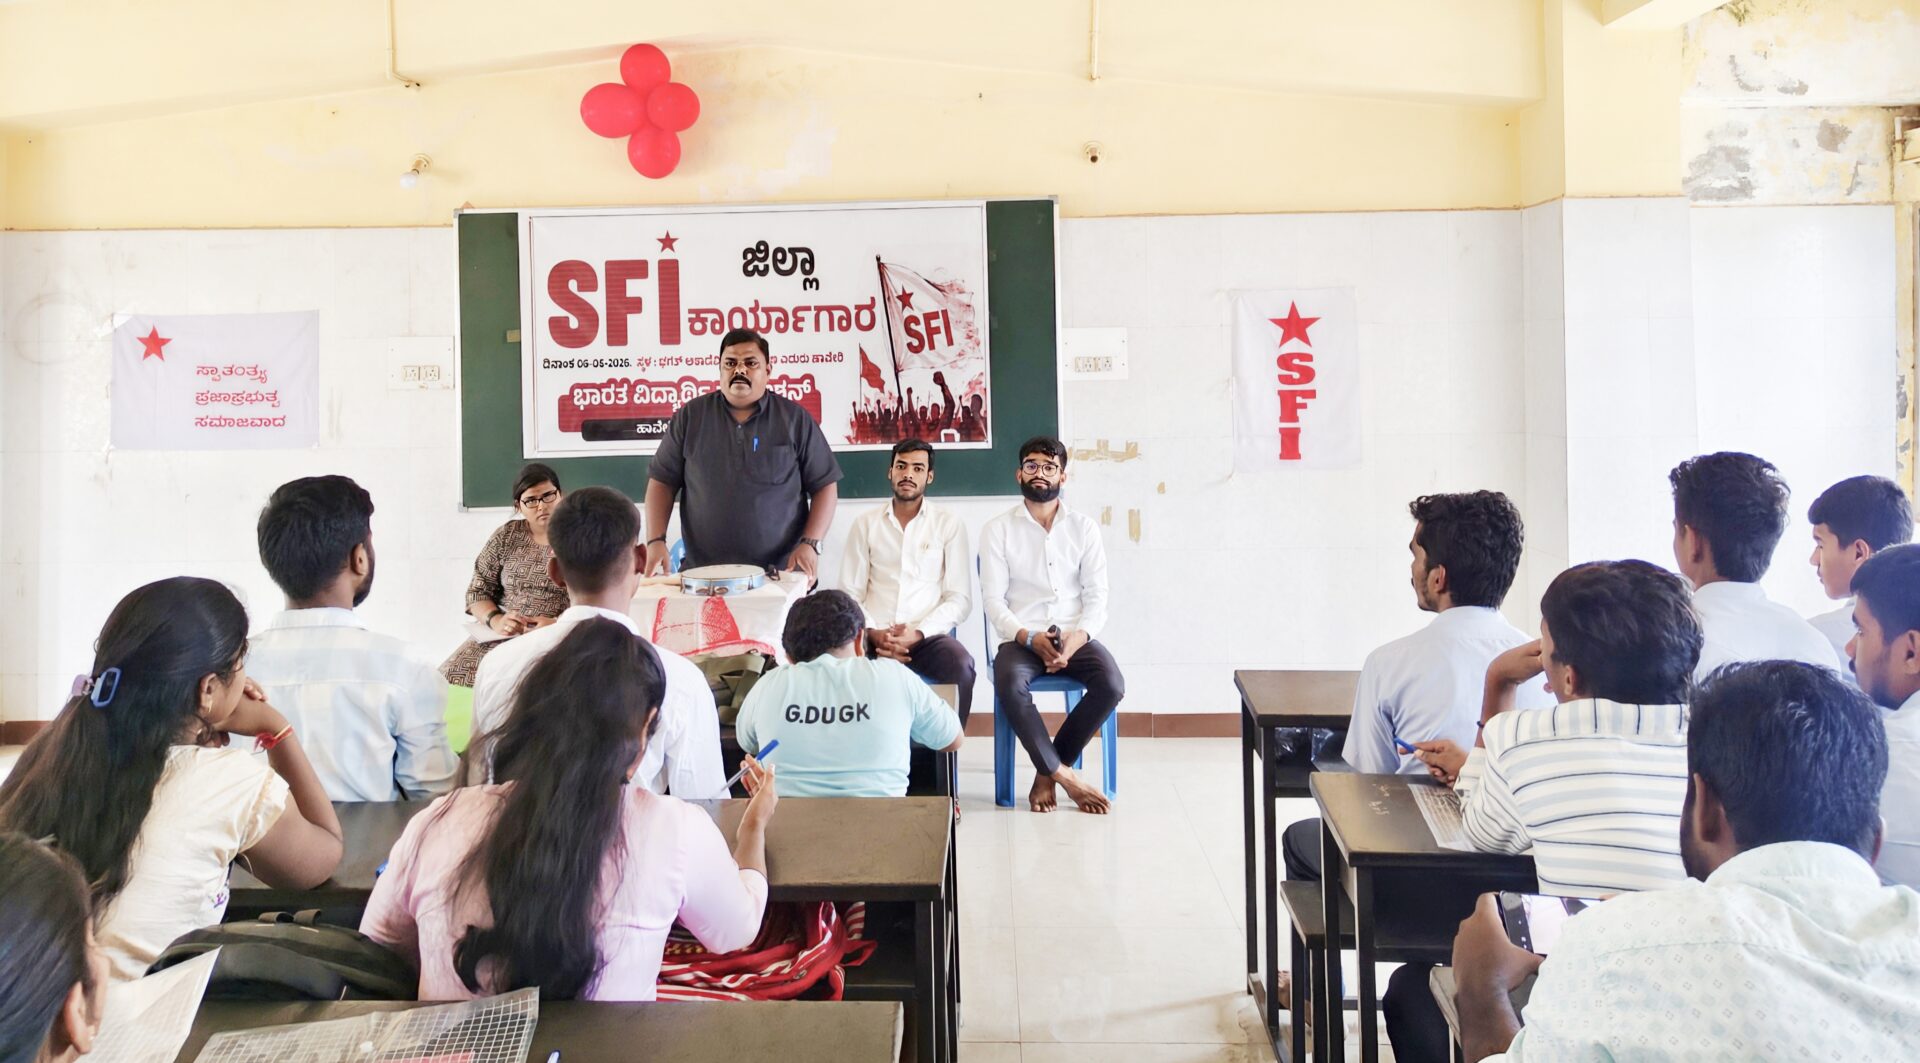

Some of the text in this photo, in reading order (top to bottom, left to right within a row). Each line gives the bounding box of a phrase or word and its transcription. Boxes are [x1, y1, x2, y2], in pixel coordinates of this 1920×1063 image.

[742, 240, 820, 291] ಜಿಲ್ಲಾ
[547, 258, 681, 349] SFI
[688, 296, 877, 336] ಕಾರ್ಯಾಗಾರ
[903, 309, 955, 354] SFI
[196, 364, 268, 384] ಸ್ವಾತಂತ್ರ್ಯ
[542, 358, 575, 369] ದಿನಾಂಕ
[658, 356, 683, 368] ಭಗತ್
[195, 390, 281, 408] ಪ್ರಜಾಪ್ರಭುತ್ವ
[573, 383, 627, 410] ಭಾರತ
[1276, 352, 1317, 461] SFI
[194, 415, 287, 428] ಸಮಾಜವಾದ
[636, 420, 670, 434] ಹಾವೇ
